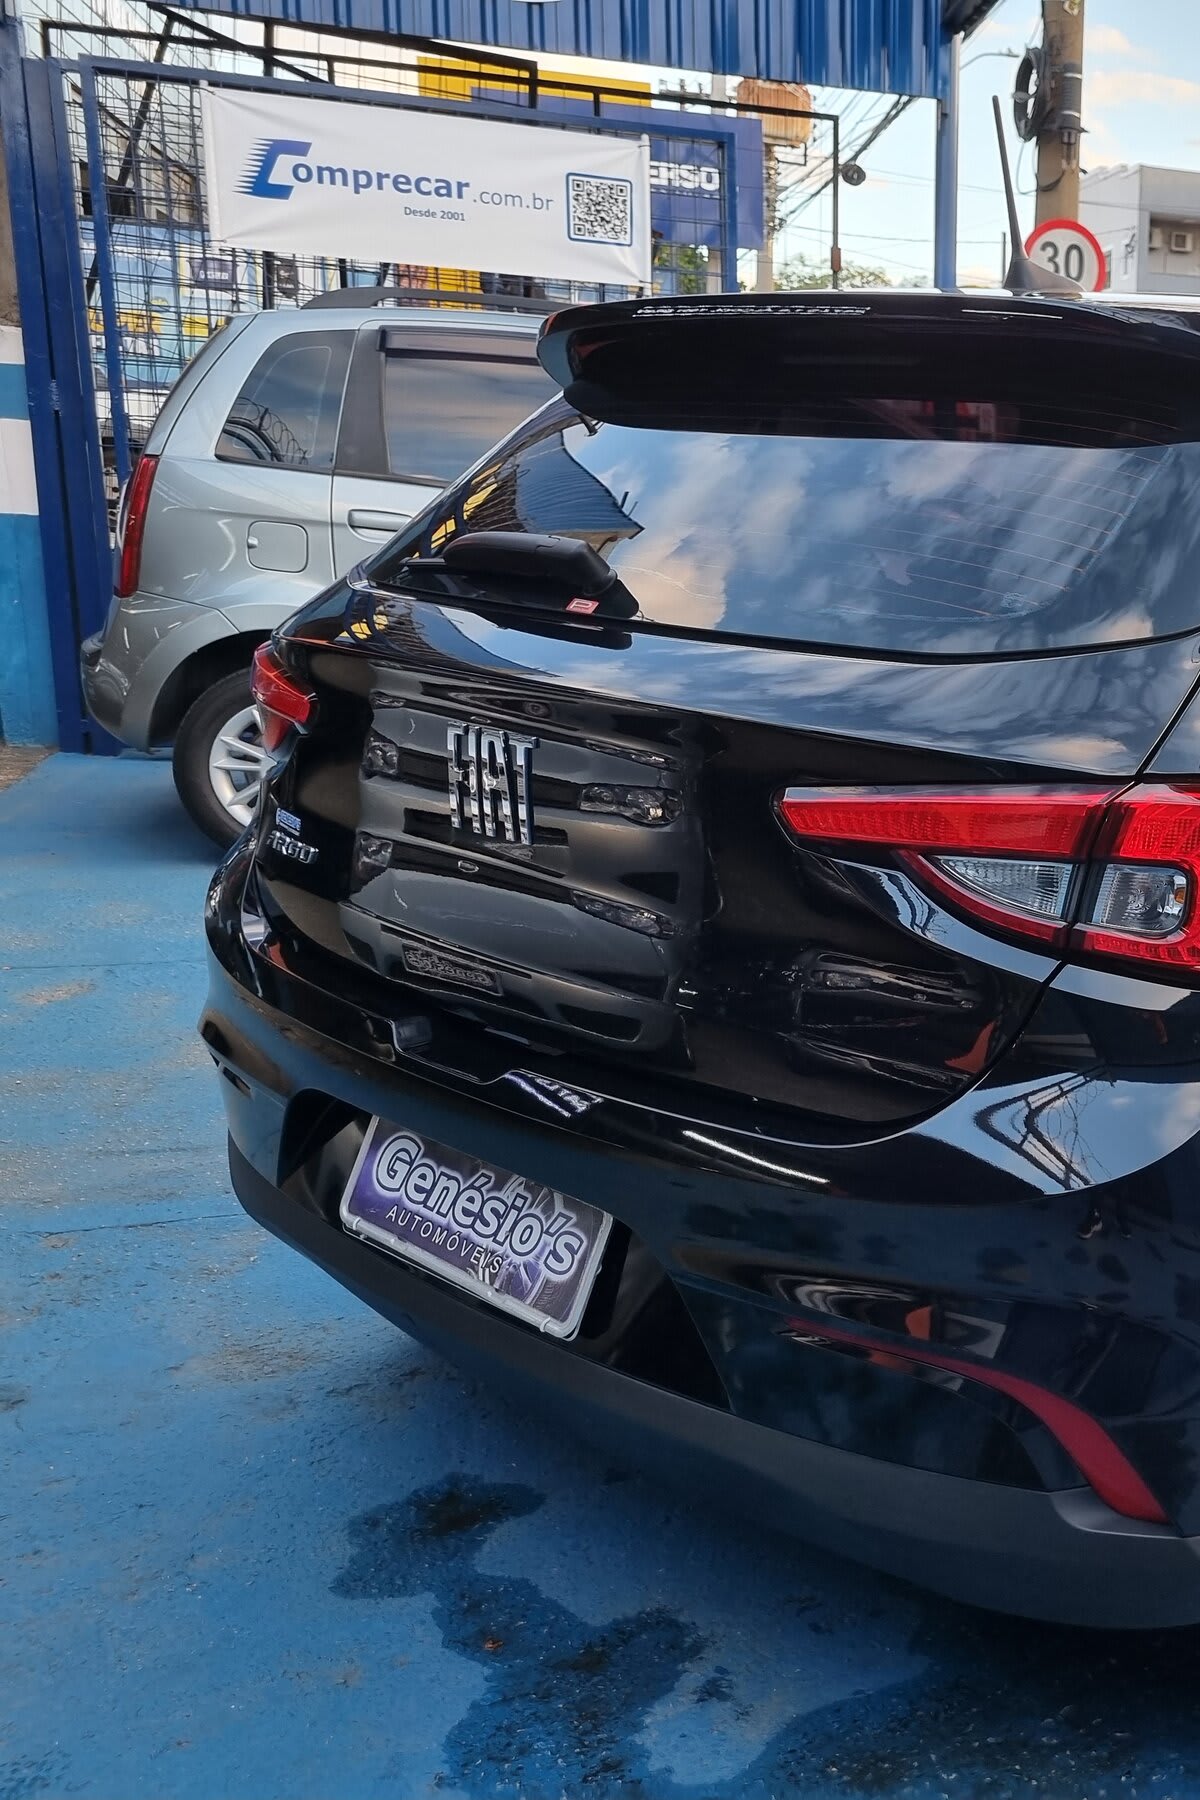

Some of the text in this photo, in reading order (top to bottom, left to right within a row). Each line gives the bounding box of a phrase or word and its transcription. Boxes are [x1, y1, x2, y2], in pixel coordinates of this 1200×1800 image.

[404, 206, 466, 222] Desde 2001
[1041, 241, 1084, 282] 30
[447, 722, 540, 845] FIAT
[376, 1134, 584, 1275] Genésio's
[386, 1205, 504, 1274] AUTOMÓVEIS
